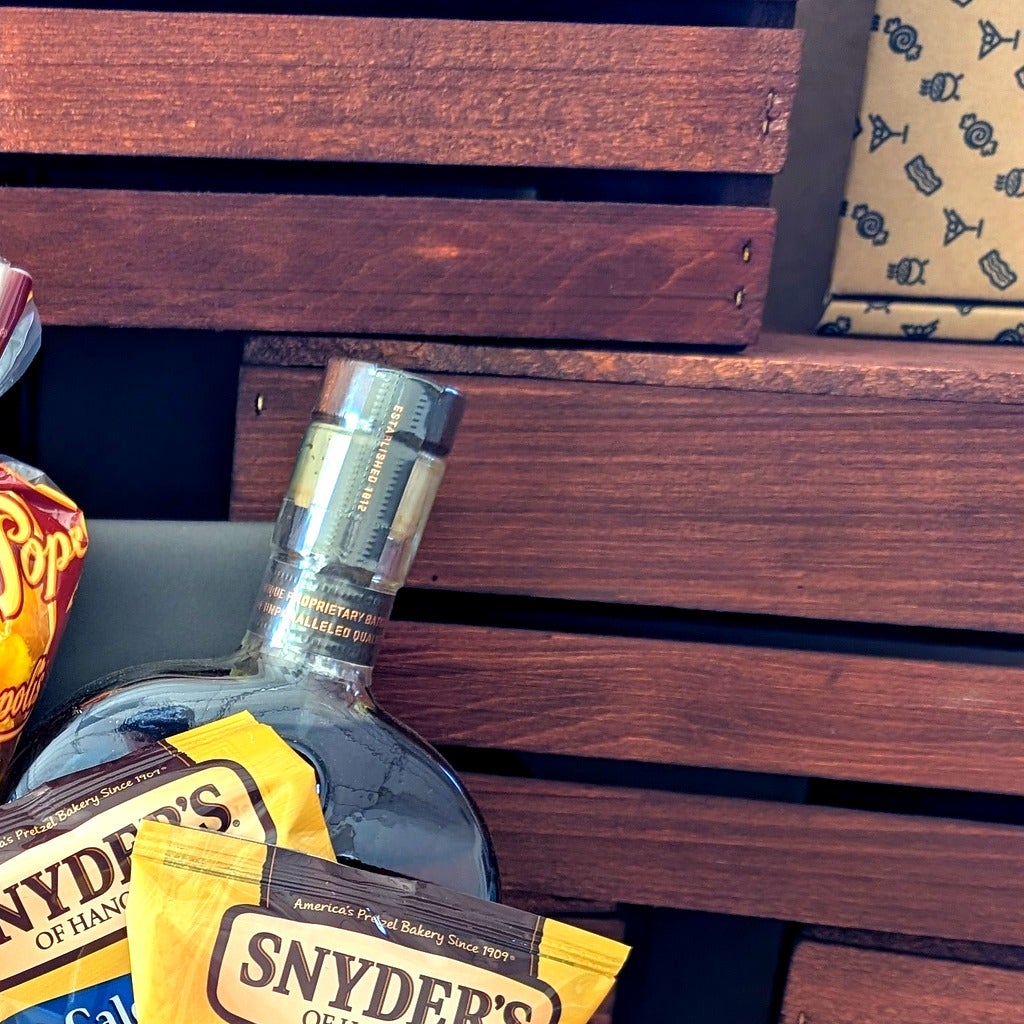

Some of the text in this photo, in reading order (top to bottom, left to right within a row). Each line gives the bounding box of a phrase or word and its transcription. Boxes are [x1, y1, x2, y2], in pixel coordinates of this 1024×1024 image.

[15, 817, 58, 842] Pretzel
[58, 794, 101, 822] Bakery
[100, 779, 134, 799] Since
[35, 926, 66, 951] OF
[293, 898, 355, 917] America's
[401, 920, 445, 945] Bakery
[448, 935, 479, 954] Since
[482, 946, 510, 962] 1909
